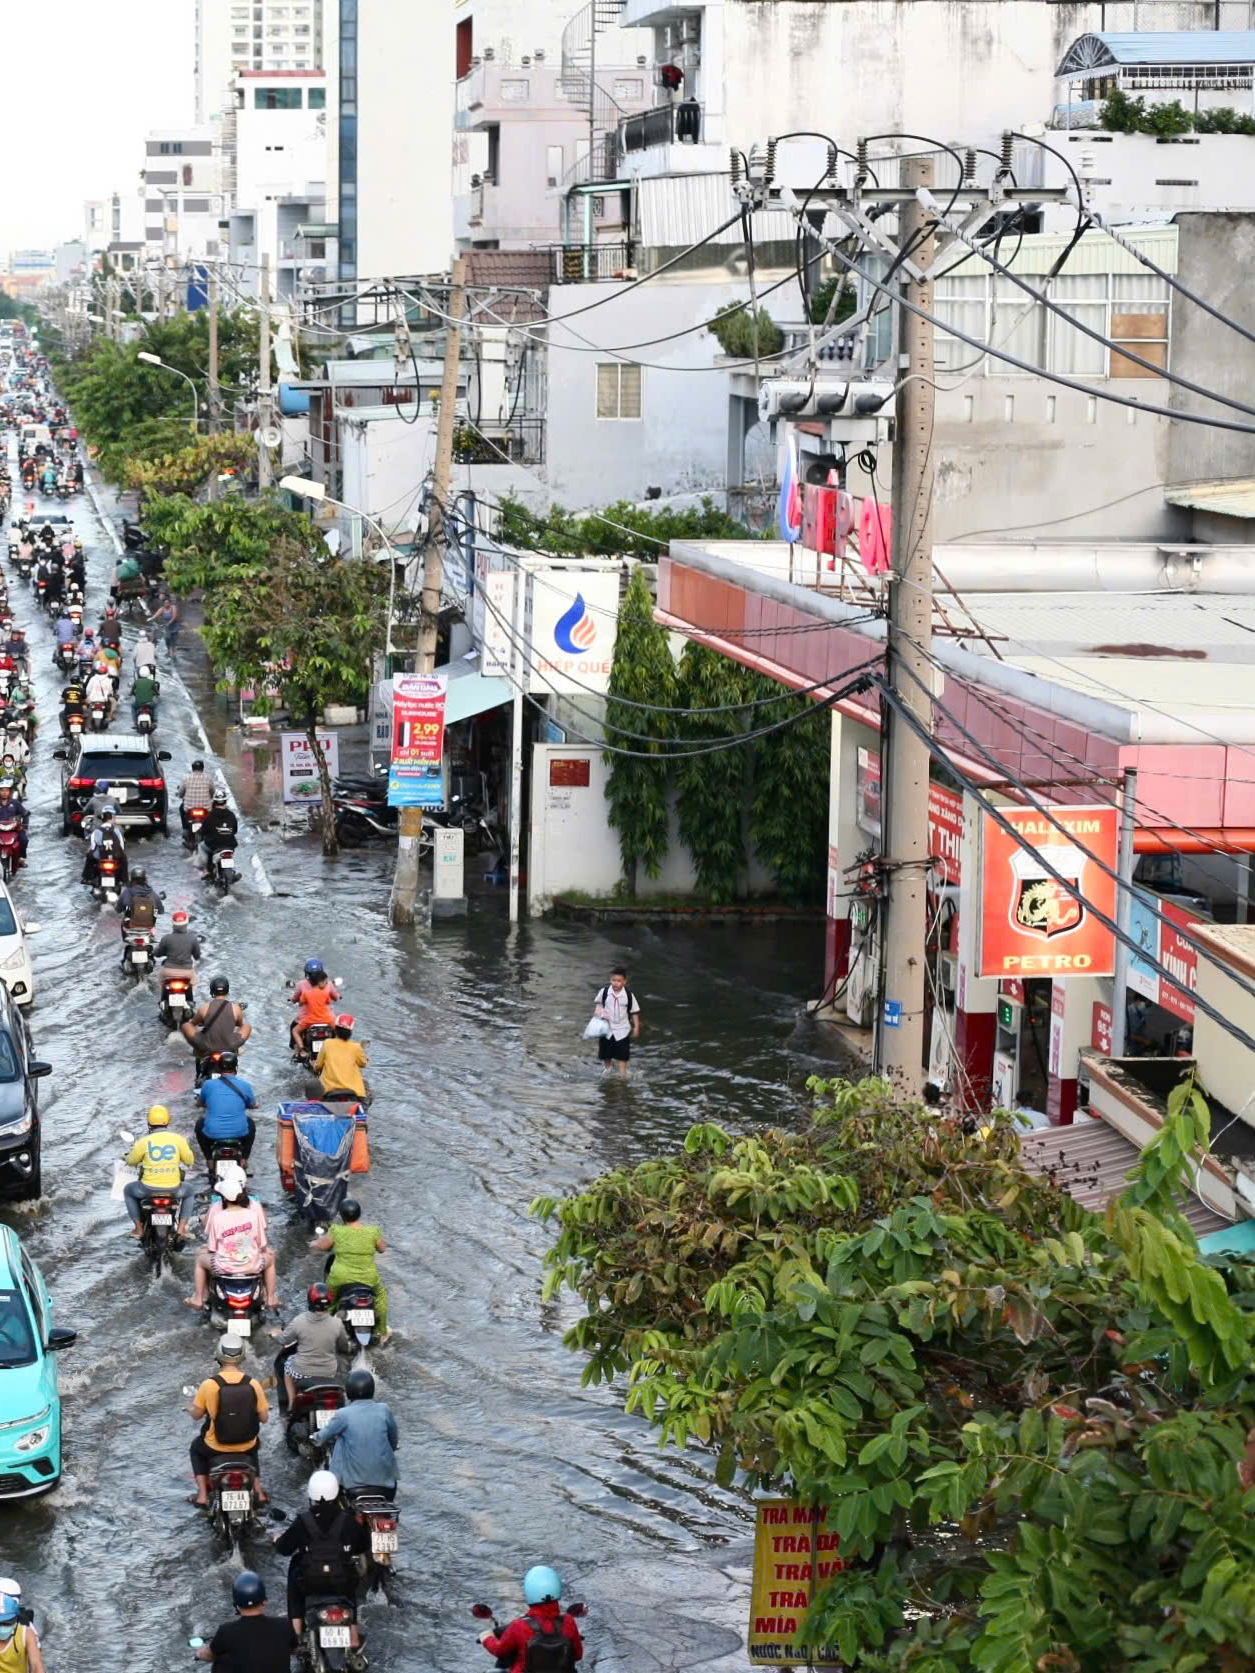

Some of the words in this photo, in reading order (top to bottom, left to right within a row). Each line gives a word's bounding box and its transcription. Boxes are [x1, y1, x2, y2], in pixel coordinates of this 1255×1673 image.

[1000, 820, 1101, 835] HALEXIM
[1003, 954, 1092, 970] PETRO
[148, 1140, 176, 1162] be
[772, 1533, 810, 1552] TRÀ
[774, 1561, 813, 1580] TRÀ
[769, 1589, 809, 1608] TRÀ
[755, 1615, 796, 1633] MÍA
